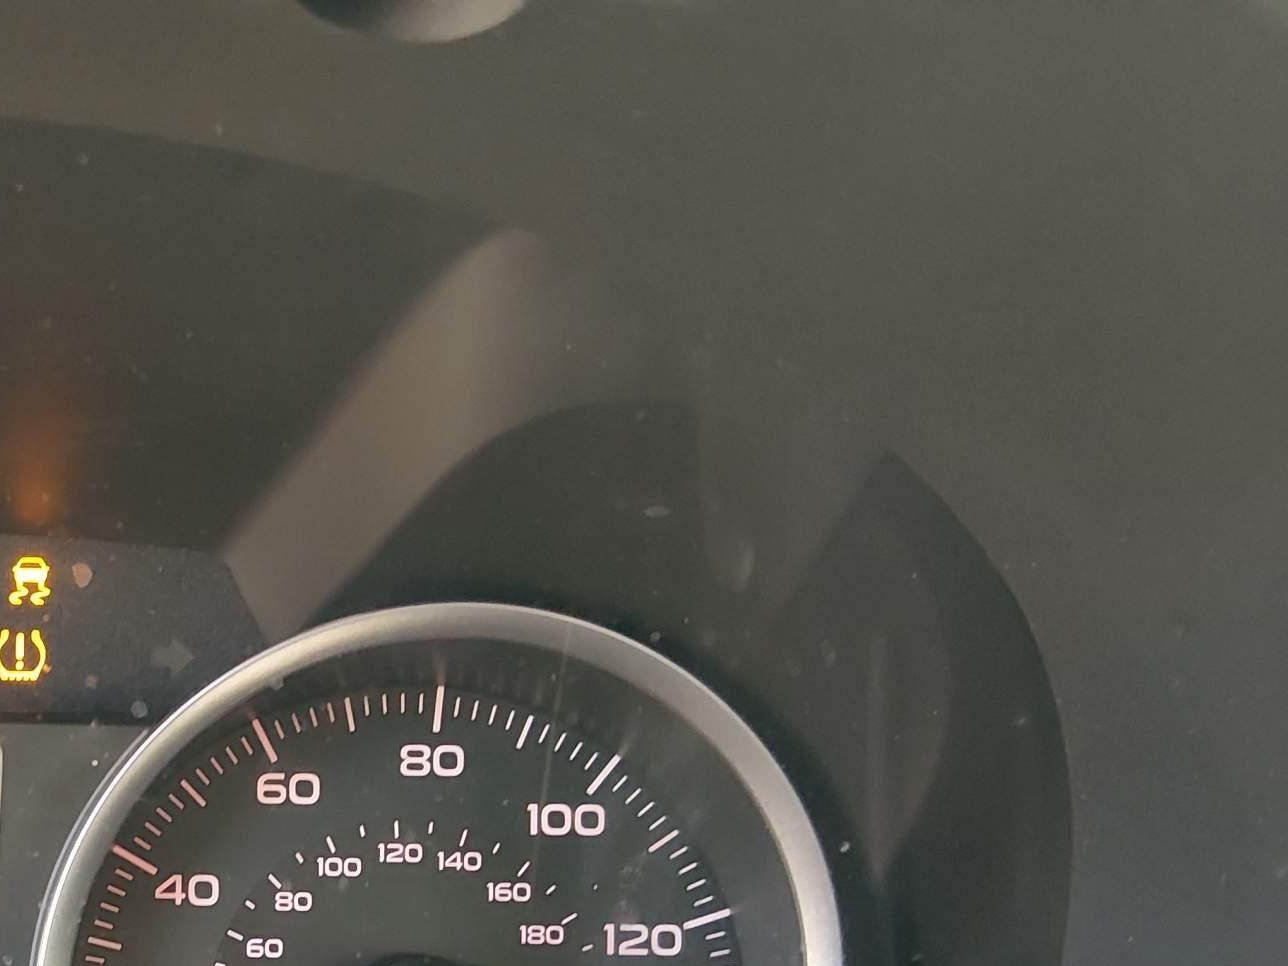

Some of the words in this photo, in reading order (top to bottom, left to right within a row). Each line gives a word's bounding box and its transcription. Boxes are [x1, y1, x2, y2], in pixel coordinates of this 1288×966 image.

[399, 744, 464, 777] 80
[257, 772, 321, 805] 60
[526, 803, 606, 836] 100
[377, 843, 423, 863] 120
[437, 851, 482, 871] 140
[316, 857, 362, 877] 100
[154, 873, 220, 907] 40
[486, 882, 532, 902] 160
[274, 891, 313, 911] 80
[519, 924, 564, 945] 180
[603, 923, 683, 956] 120
[246, 938, 284, 958] 60
